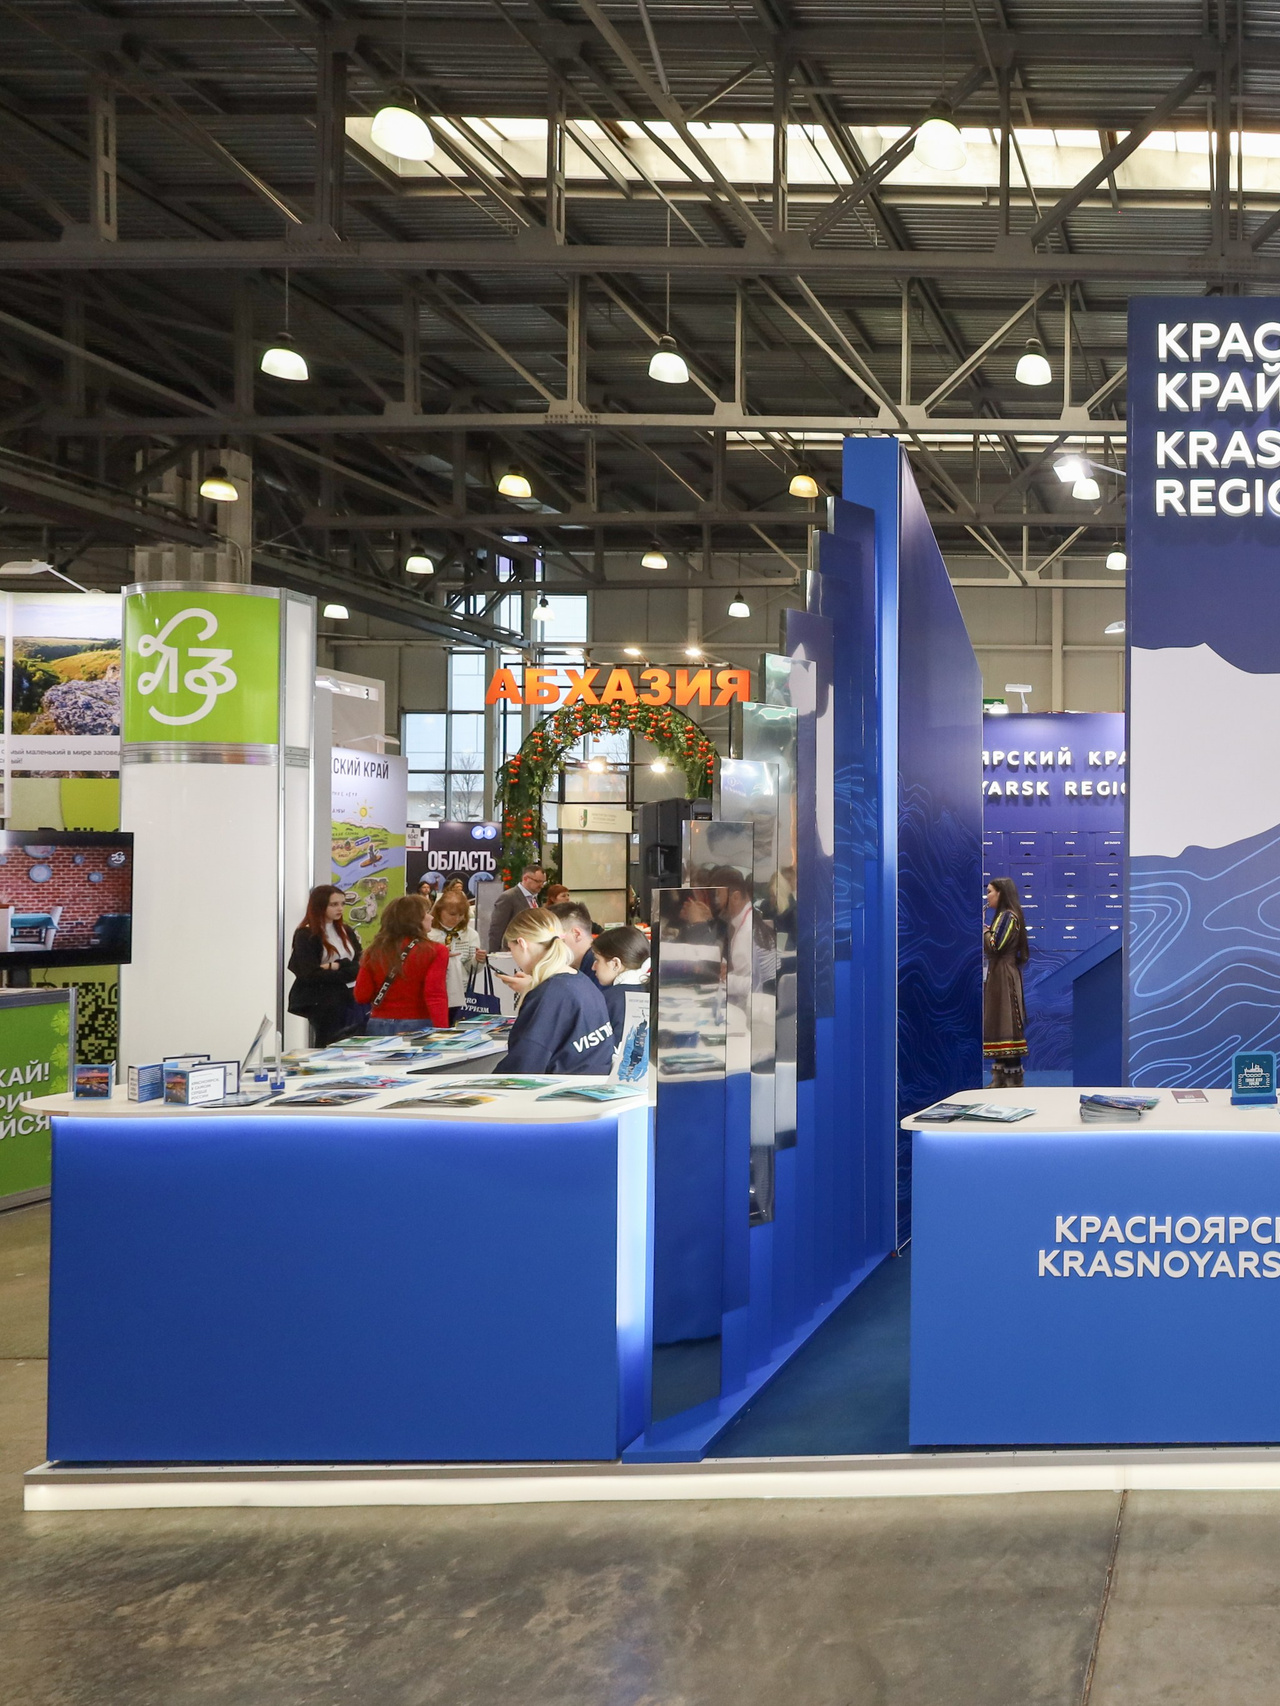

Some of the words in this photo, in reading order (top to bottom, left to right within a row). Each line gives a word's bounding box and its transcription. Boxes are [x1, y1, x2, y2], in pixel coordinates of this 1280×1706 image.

[485, 668, 750, 707] АБХАЗИЯ
[332, 757, 360, 776] СКИЙ
[364, 760, 389, 779] КРАЙ
[428, 850, 496, 871] ОБЛАСТЬ
